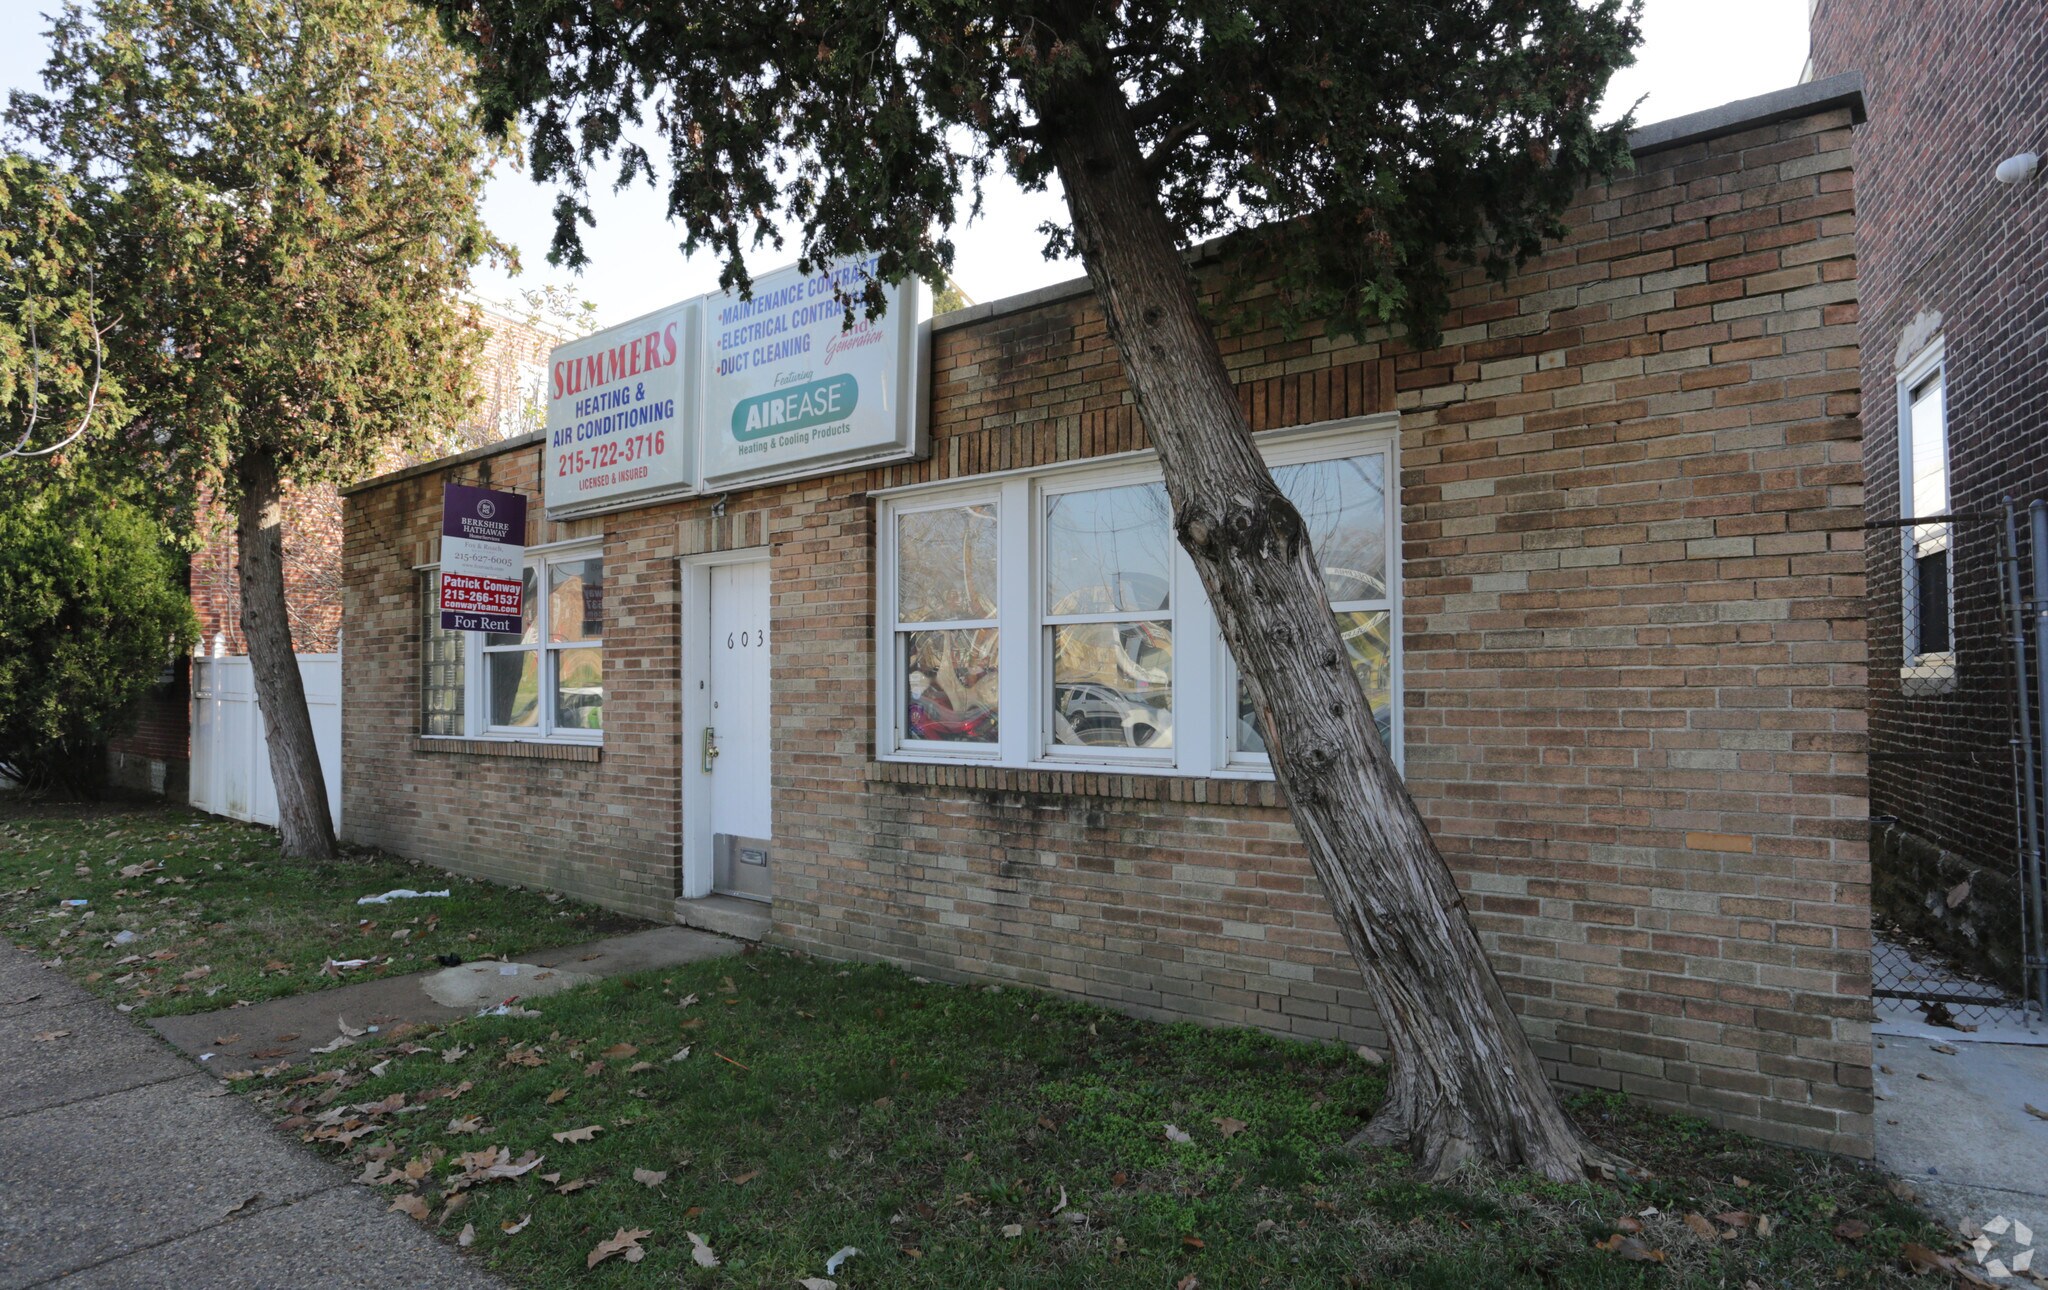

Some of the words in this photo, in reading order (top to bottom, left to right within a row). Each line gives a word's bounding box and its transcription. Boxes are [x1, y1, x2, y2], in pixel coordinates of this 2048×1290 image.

[722, 283, 804, 326] MAINTENANCE
[722, 320, 788, 351] ELECTRICAL
[824, 330, 884, 366] Generation
[553, 321, 678, 400] SUMMERS
[720, 352, 748, 377] DUCT
[752, 333, 811, 368] CLEANING
[774, 370, 814, 387] Featuring
[575, 386, 630, 418] HEATING
[635, 382, 646, 401] &
[553, 428, 573, 448] AIR
[576, 399, 675, 441] CONDITIONING
[738, 440, 768, 456] Heating
[771, 438, 777, 448] &
[779, 431, 810, 447] Cooling
[812, 423, 851, 440] Products
[559, 430, 665, 477] 215-722-3716
[579, 475, 610, 491] LICENSED
[612, 475, 617, 485] &
[618, 466, 648, 481] INSURED
[461, 517, 510, 531] BERKSHIRE
[463, 525, 507, 537] HATHAWAY
[454, 552, 513, 567] 215-627-6005
[444, 575, 480, 590] Patrick
[483, 580, 521, 595] Conway
[444, 589, 519, 605] 215-266-1537
[444, 600, 518, 613] conwayTeam.com
[454, 615, 478, 629] For
[480, 617, 510, 631] Rent
[727, 629, 764, 649] 603
